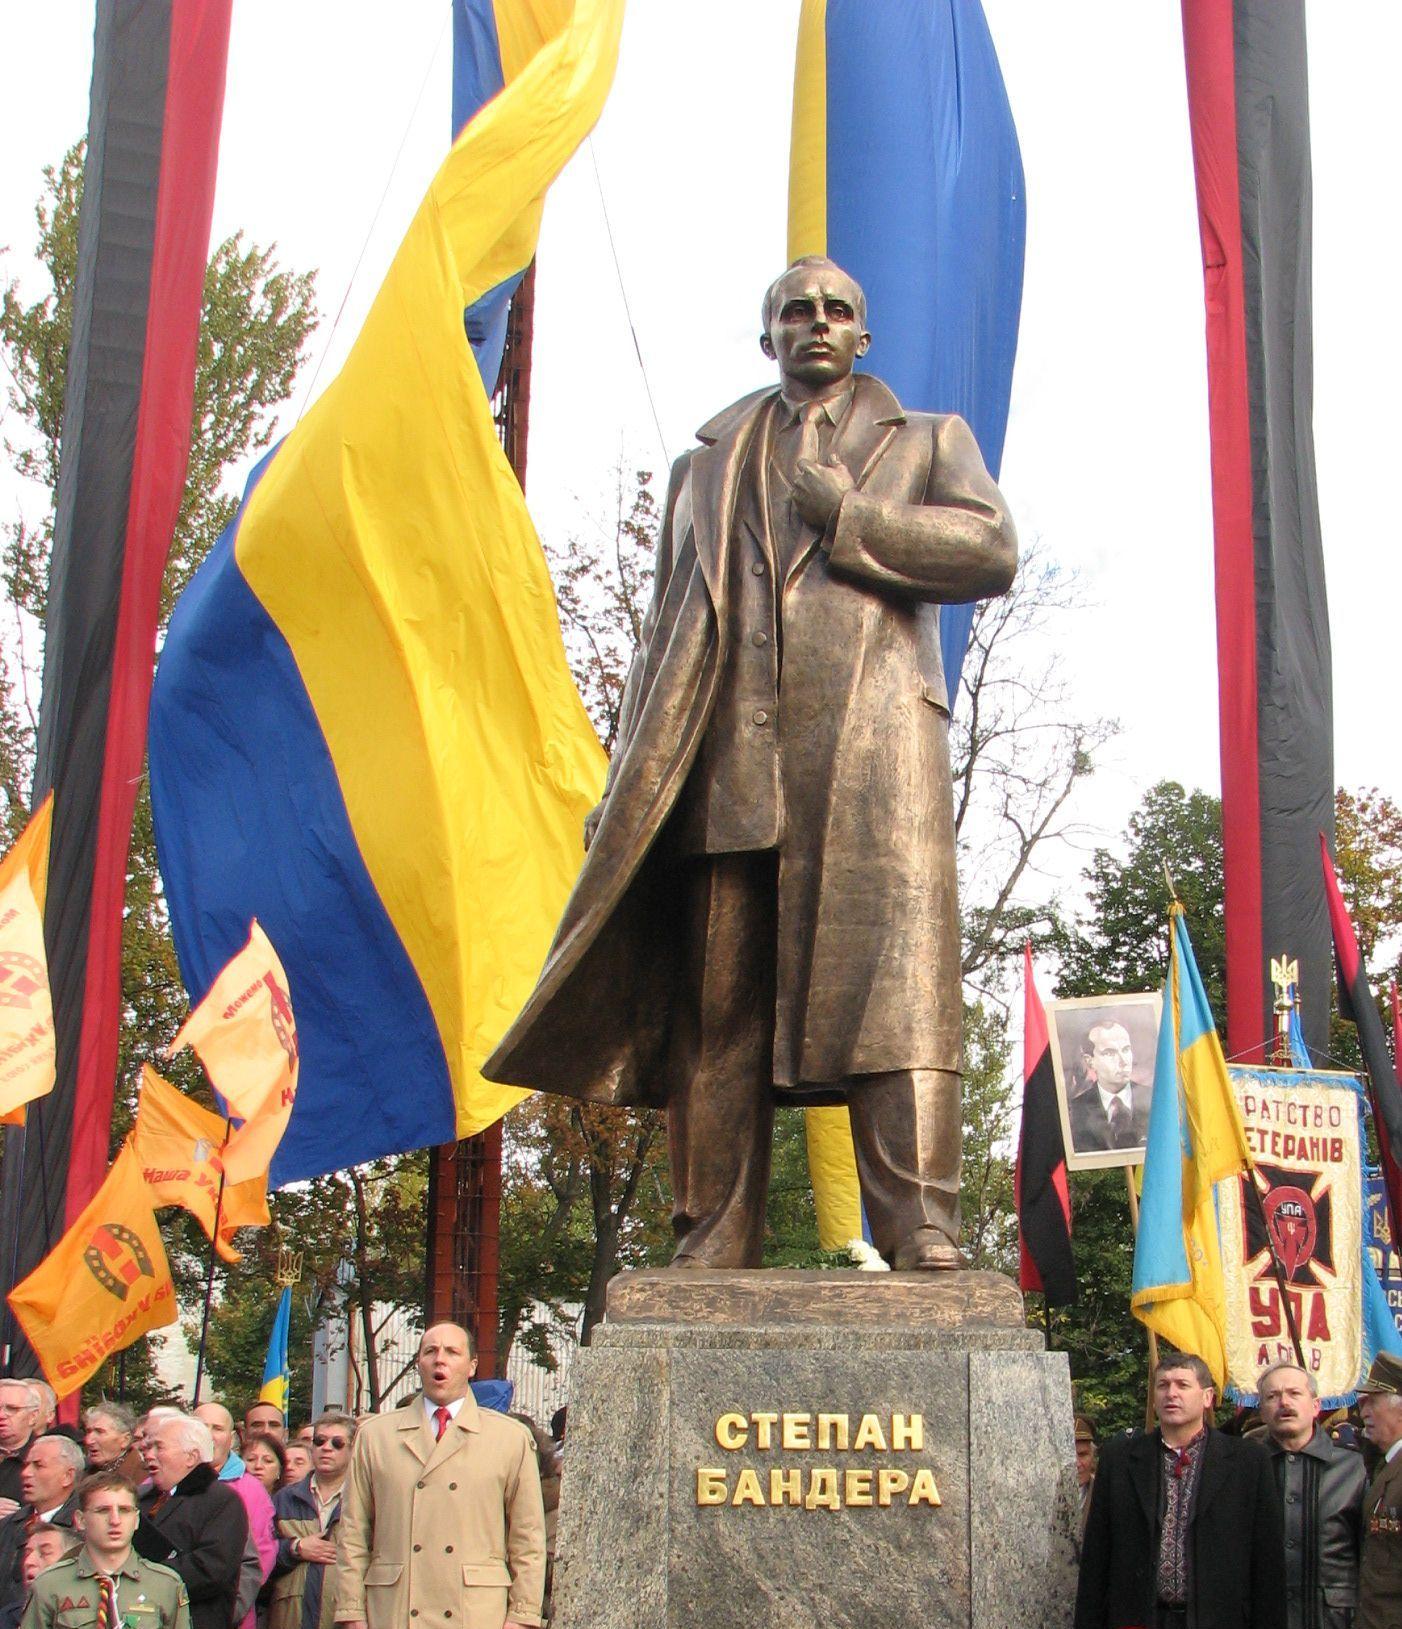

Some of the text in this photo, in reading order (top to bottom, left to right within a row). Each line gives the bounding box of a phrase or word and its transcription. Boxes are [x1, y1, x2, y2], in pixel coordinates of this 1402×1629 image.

[1244, 1095, 1341, 1128] РАТСТВО
[1243, 1127, 1344, 1162] ЕТЕРАНІВ
[1281, 1203, 1302, 1216] УПА
[715, 1412, 925, 1451] СТЕПАН
[697, 1468, 942, 1511] БАНДЕРА
